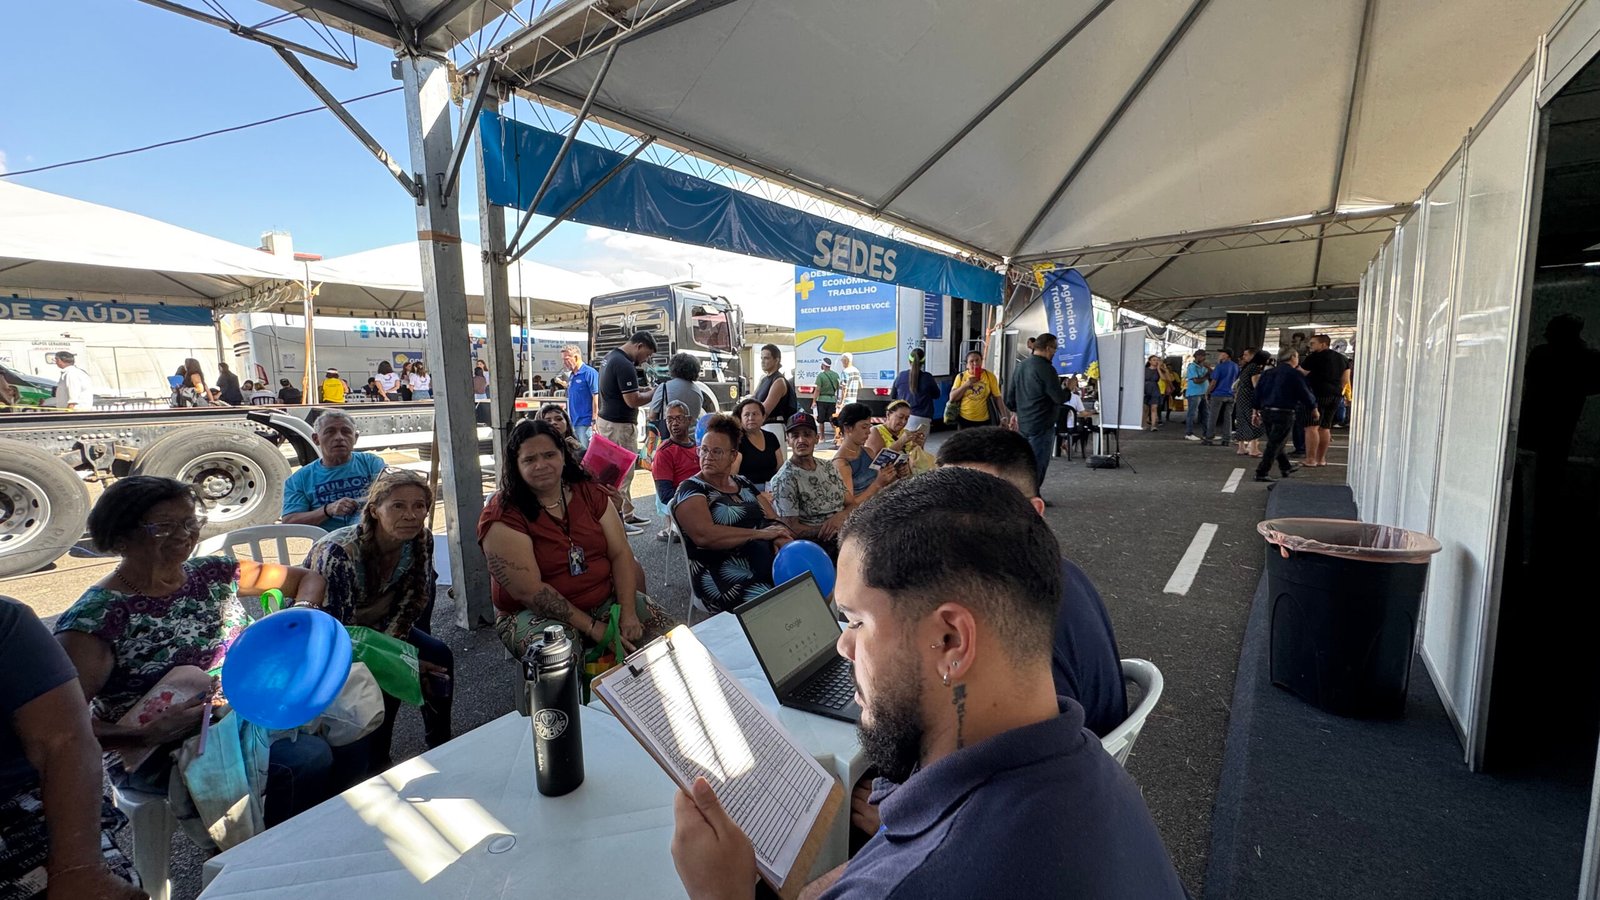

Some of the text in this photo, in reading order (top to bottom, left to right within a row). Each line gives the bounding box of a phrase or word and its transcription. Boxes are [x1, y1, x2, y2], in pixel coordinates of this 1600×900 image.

[813, 230, 897, 281] SEDES
[828, 286, 877, 297] TRABALHO
[42, 303, 151, 323] SAÚDE
[800, 306, 820, 314] SEDET
[820, 305, 838, 313] MAIS
[1051, 286, 1066, 348] Trabalhador
[1061, 284, 1076, 325] Agência
[1069, 327, 1078, 340] do
[375, 327, 399, 338] NA
[785, 617, 802, 631] Google
